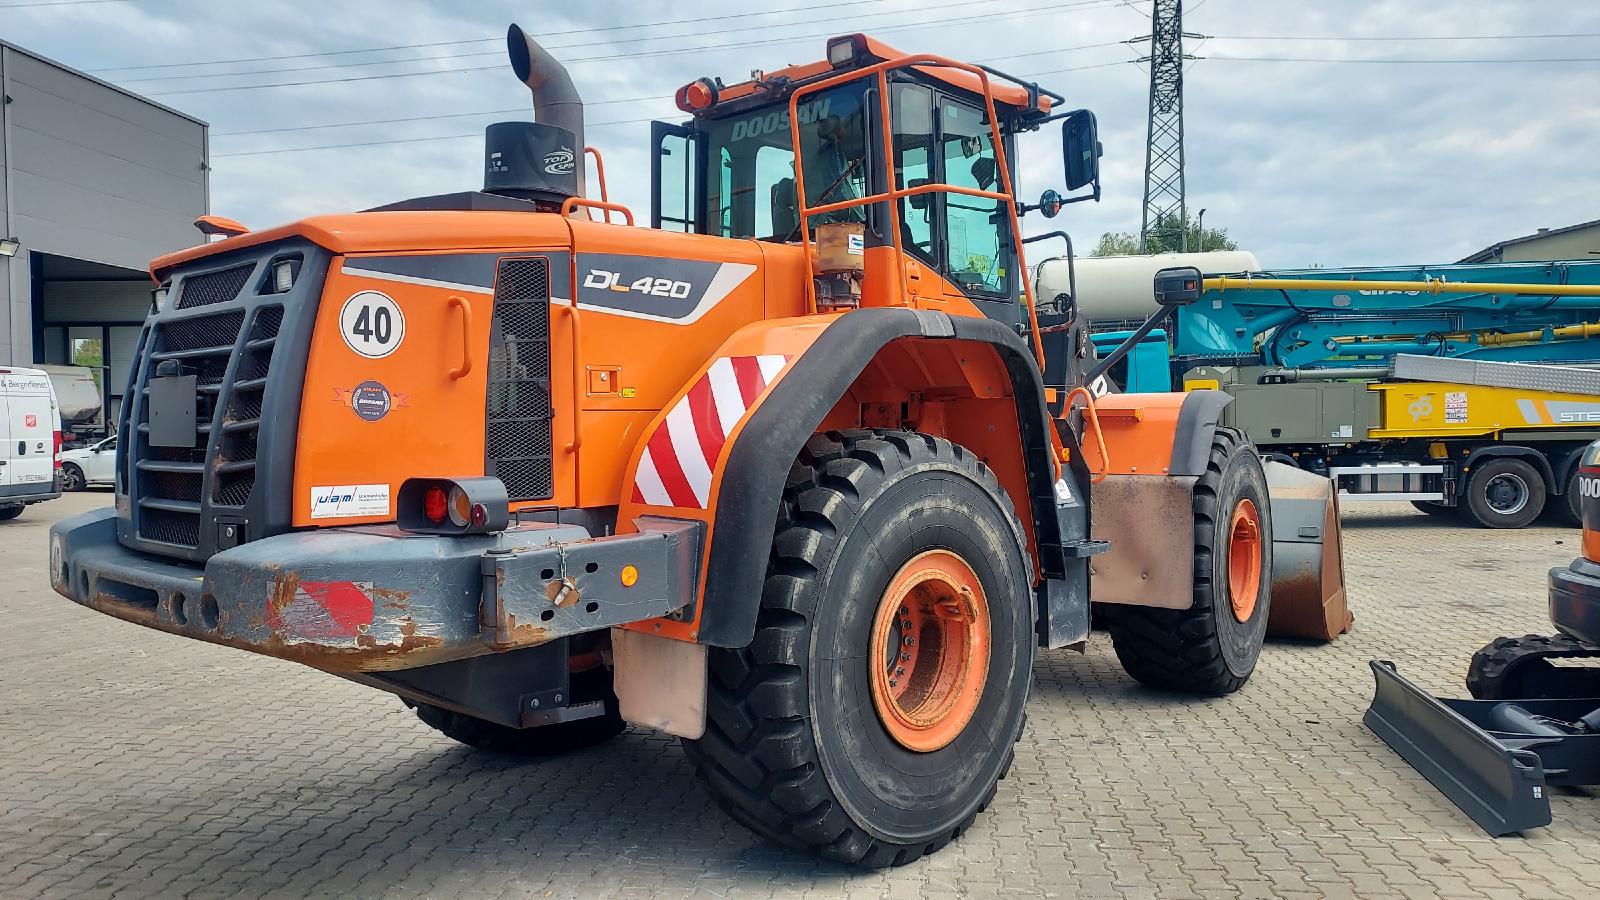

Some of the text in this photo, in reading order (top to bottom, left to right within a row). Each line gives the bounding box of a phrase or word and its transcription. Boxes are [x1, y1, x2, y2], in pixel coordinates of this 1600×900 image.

[731, 98, 832, 142] DOOSAN
[558, 162, 574, 170] SPIN
[583, 269, 692, 299] DL420
[353, 305, 392, 344] 40
[358, 398, 385, 406] DOOSAN
